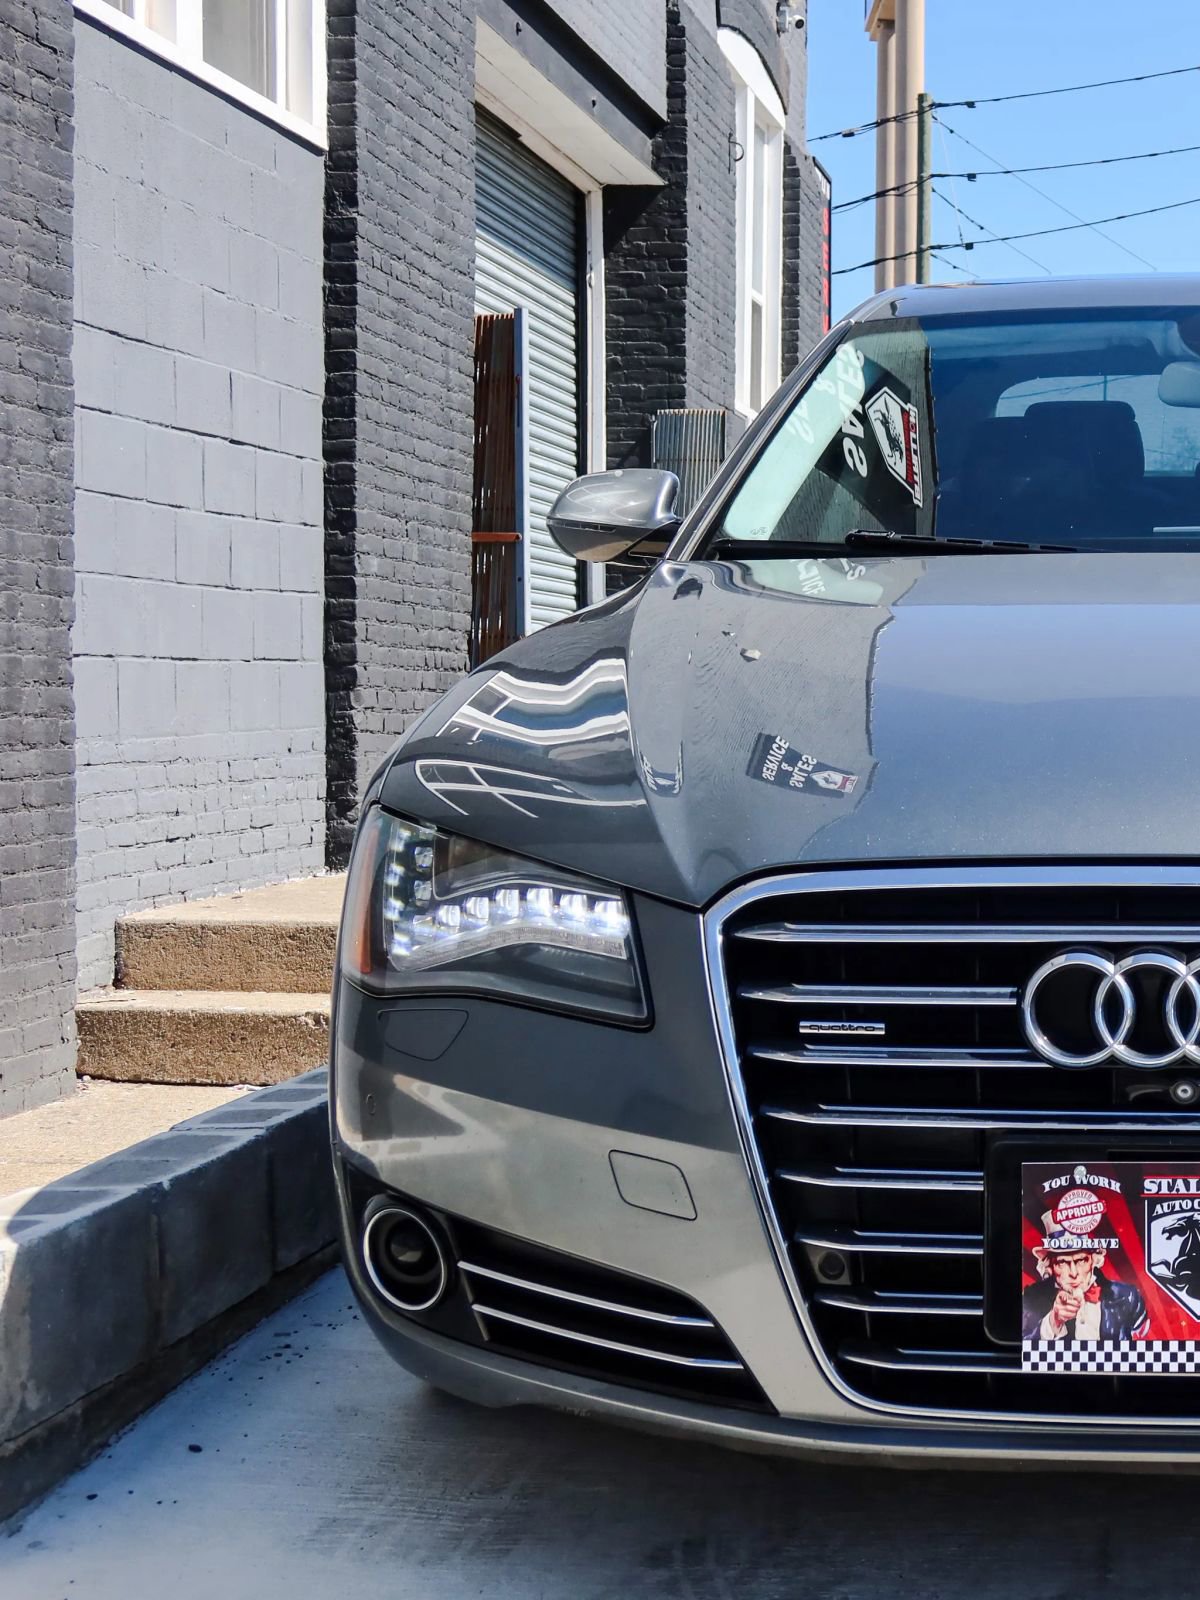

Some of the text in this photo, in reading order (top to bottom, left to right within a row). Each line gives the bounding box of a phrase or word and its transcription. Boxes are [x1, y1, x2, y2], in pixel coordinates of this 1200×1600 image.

[808, 1023, 876, 1033] quattro
[1042, 1174, 1122, 1194] YOU WORK
[1056, 1202, 1104, 1222] APPROVED
[1152, 1199, 1192, 1217] AUTO
[1041, 1238, 1119, 1249] YOU DRIVE
